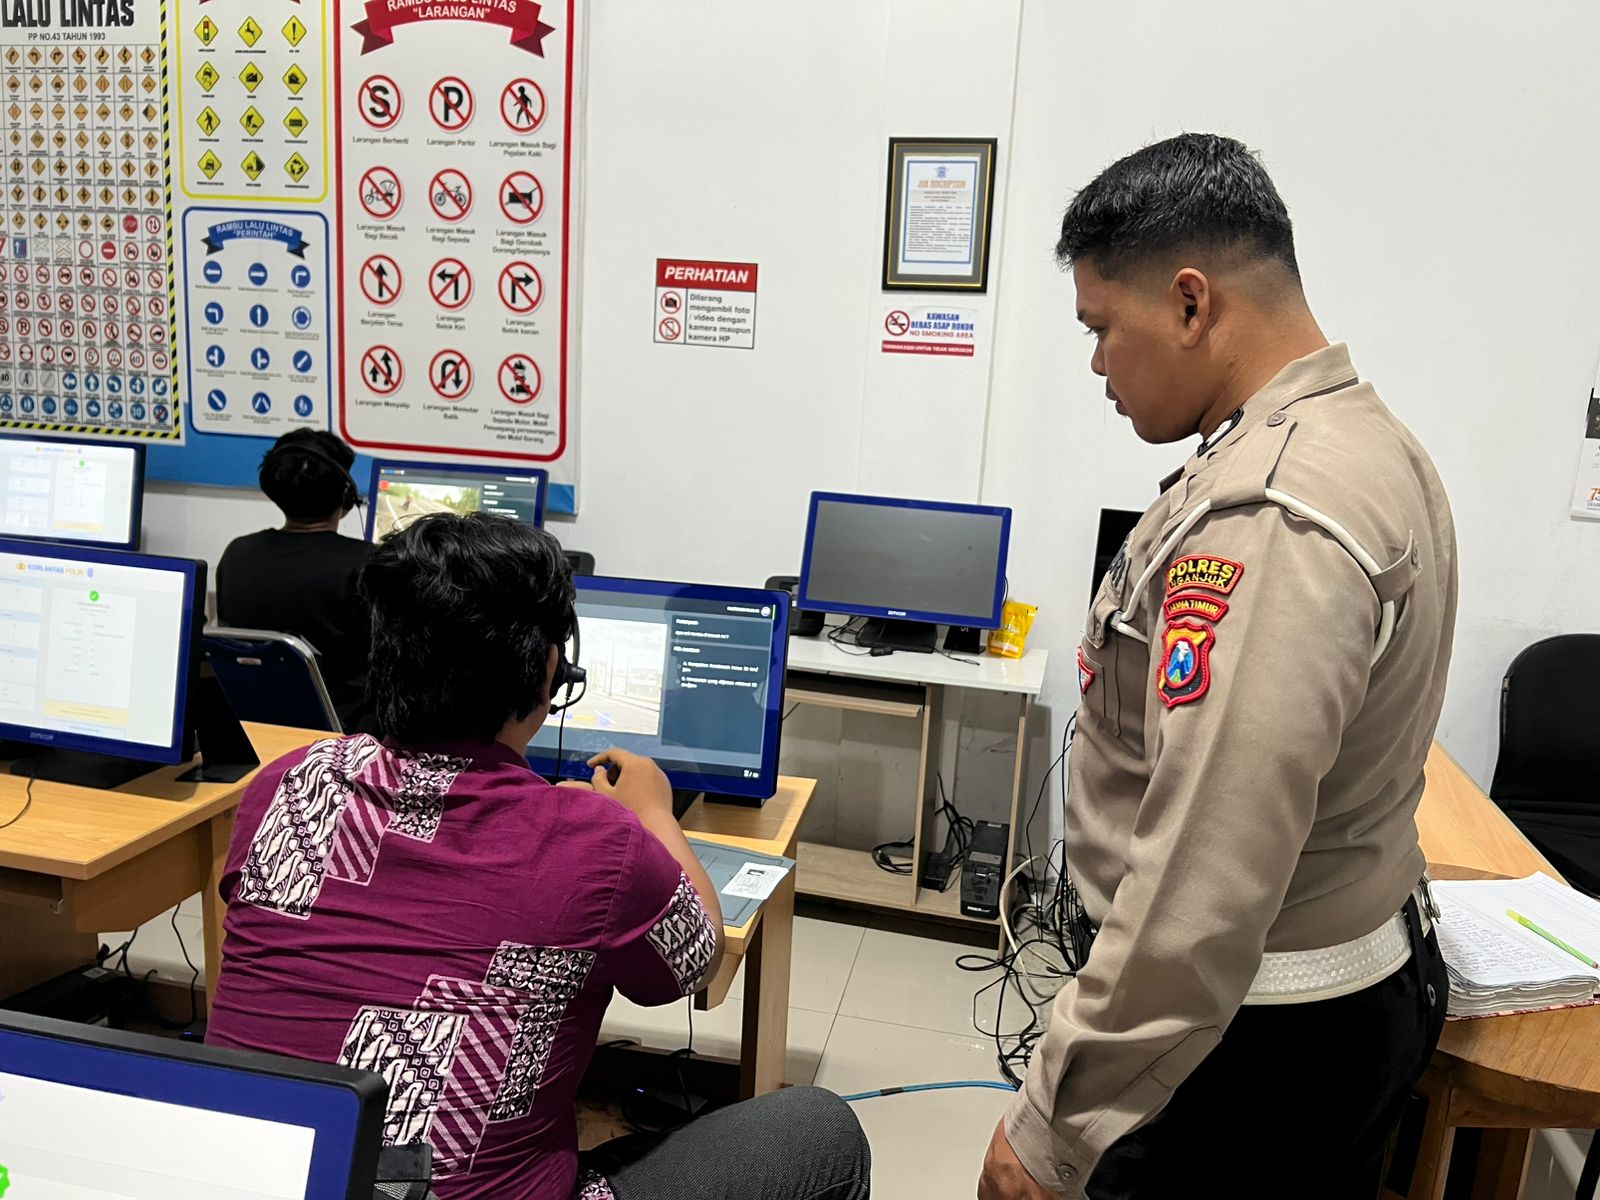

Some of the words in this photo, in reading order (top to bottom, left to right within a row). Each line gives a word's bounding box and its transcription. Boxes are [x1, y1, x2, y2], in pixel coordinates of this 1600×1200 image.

[387, 0, 431, 12] RAM
[1, 0, 50, 27] LALU
[60, 0, 134, 27] LINTAS
[28, 33, 38, 41] PP
[40, 33, 60, 41] NO.43
[62, 33, 87, 41] TAHUN
[89, 32, 106, 41] 1993
[352, 136, 381, 145] Larangan
[383, 137, 409, 145] Berhenti
[427, 138, 456, 147] Larangan
[457, 139, 475, 147] Parkir
[489, 140, 519, 149] Larangan
[520, 141, 541, 149] Masuk
[542, 141, 556, 150] Bagi
[215, 222, 243, 234] RAMBU
[244, 221, 264, 230] LALU
[266, 223, 294, 237] LINTAS
[356, 224, 385, 232] Larangan
[425, 226, 455, 236] Larangan
[495, 229, 526, 238] Larangan
[664, 266, 749, 283] PERHATIAN
[690, 293, 723, 304] Dilarang
[689, 304, 732, 313] mengambil
[734, 306, 750, 314] foto
[367, 311, 396, 319] Larangan
[436, 314, 465, 323] Larangan
[693, 314, 715, 322] video
[716, 316, 746, 325] dengan
[927, 313, 960, 321] KAWASAN
[505, 318, 535, 328] Larangan
[933, 322, 950, 330] ASAP
[689, 324, 717, 332] kamera
[719, 326, 751, 335] maupun
[688, 333, 717, 342] kamera
[1168, 559, 1235, 582] POLRES
[1189, 600, 1220, 615] TIMUR
